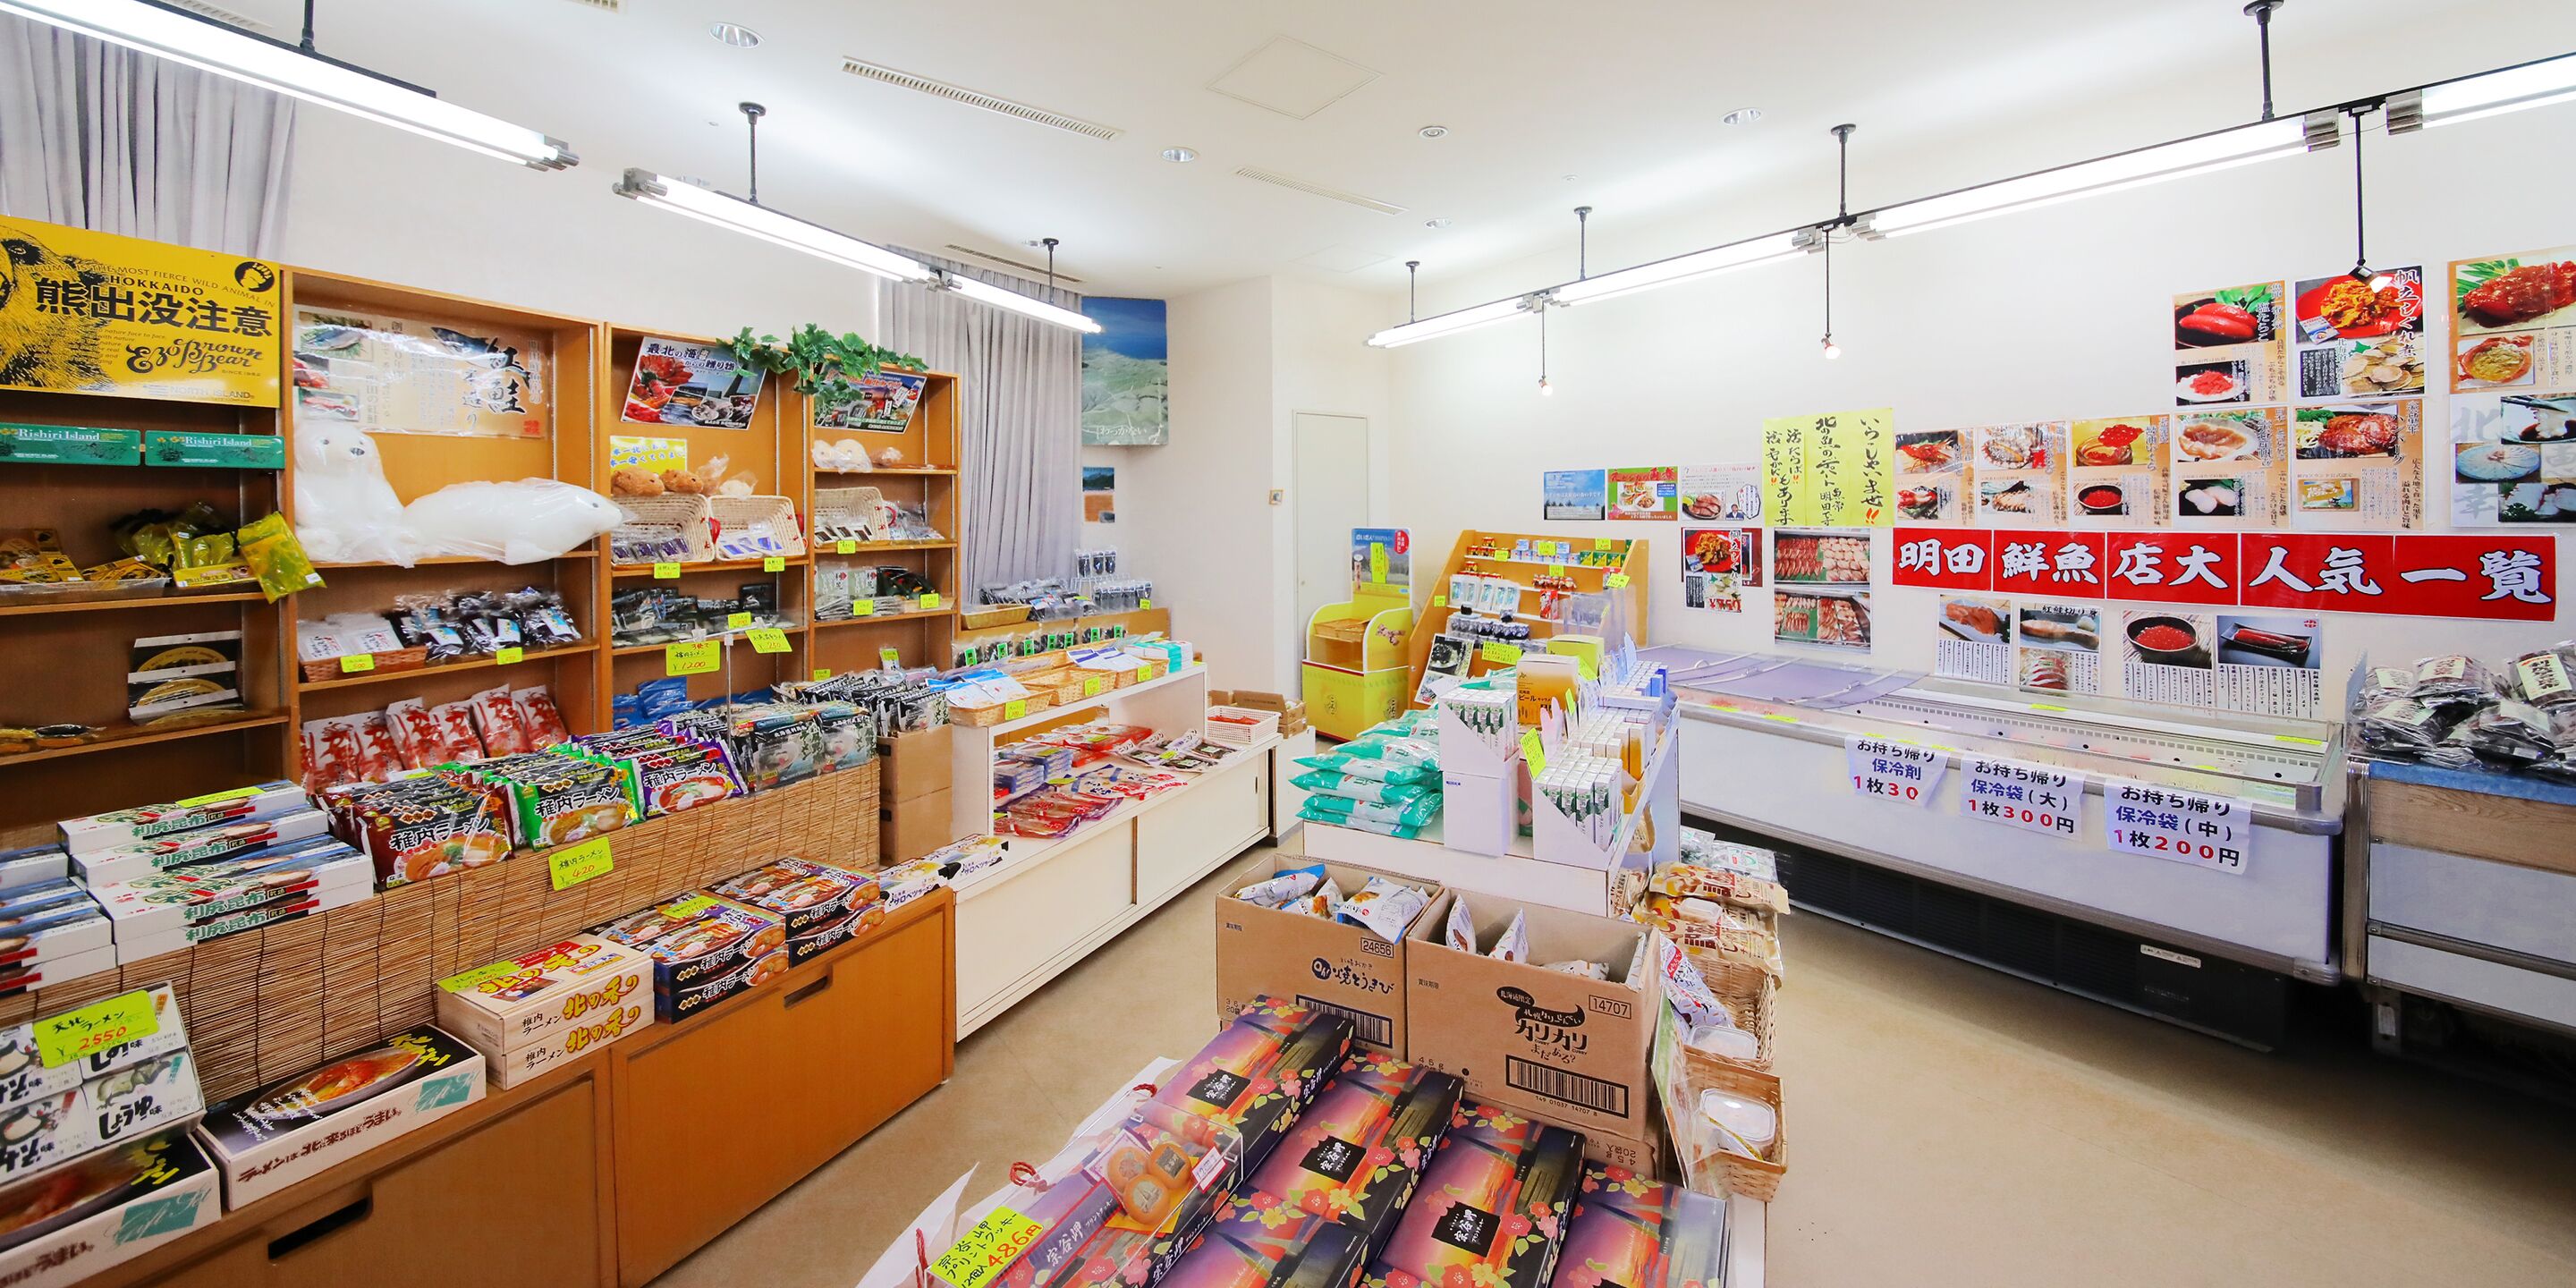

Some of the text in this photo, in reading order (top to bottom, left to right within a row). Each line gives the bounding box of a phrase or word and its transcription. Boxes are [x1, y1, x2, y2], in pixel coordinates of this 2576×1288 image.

[109, 274, 204, 296] HOKKAIDO
[117, 267, 150, 275] MOST
[153, 270, 187, 283] FIERCE
[192, 277, 218, 289] WILD
[222, 285, 260, 303] ANIMAL
[264, 298, 275, 309] IN
[35, 276, 273, 337] 熊出没注意
[2395, 269, 2419, 356] 帆立しぐれ煮
[125, 344, 182, 374] Ezo
[18, 428, 100, 441] Rishiri Island
[185, 436, 252, 446] Rishiri Island
[1815, 416, 1841, 487] 北の魚のデパート
[1898, 538, 2554, 604] 明田鮮魚店大人気一覧
[1857, 739, 1936, 763] お持ち帰り
[644, 762, 716, 788] 稚内ラーメン
[1872, 758, 1922, 781] 保冷剤
[1974, 759, 2068, 789] お持ち帰り
[535, 786, 620, 818] 稚内ラーメン
[1853, 775, 1919, 801] 1枚30
[2121, 785, 2231, 818] お持ち帰り
[131, 813, 208, 837] 利尻昆布
[1969, 798, 2075, 834] 1枚300円
[390, 818, 490, 851] 稚内ラーメン
[2114, 827, 2240, 868] 1枚200円
[151, 840, 229, 868] 利尻昆布
[572, 864, 595, 877] 420
[183, 891, 267, 920] 利尻昆布
[185, 911, 267, 941] 利尻昆布
[700, 938, 755, 971] 稚内ラーメン
[1362, 940, 1392, 956] 24656
[1340, 957, 1373, 970] 札幌おかき
[702, 966, 759, 1000] 稚内ラーメン
[1333, 964, 1394, 995] 焼とうきび
[563, 974, 640, 1021] 北の香り
[1593, 996, 1630, 1016] 14707
[52, 1011, 125, 1035] 天北ラーメン
[521, 1013, 543, 1028] 稚内
[523, 1014, 562, 1036] ラーメン
[566, 1005, 641, 1054] 北の香り
[1514, 1019, 1588, 1052] カリカリ
[80, 1026, 127, 1051] 2550
[526, 1047, 547, 1063] 稚内
[527, 1048, 565, 1070] ラーメン
[1205, 1073, 1233, 1099] 宗谷岬
[1303, 1067, 1323, 1099] 宗谷岬
[98, 1095, 163, 1140] しょうゆ味
[1549, 1098, 1568, 1108] 01037
[1572, 1105, 1590, 1114] 14707
[1319, 1141, 1346, 1172] 宗谷岬
[1453, 1208, 1478, 1243] 宗谷岬
[946, 1214, 1017, 1279] プリントクッキー
[987, 1224, 1042, 1267] 486円
[1046, 1221, 1085, 1267] 宗谷岬
[1151, 1236, 1183, 1284] 宗谷岬
